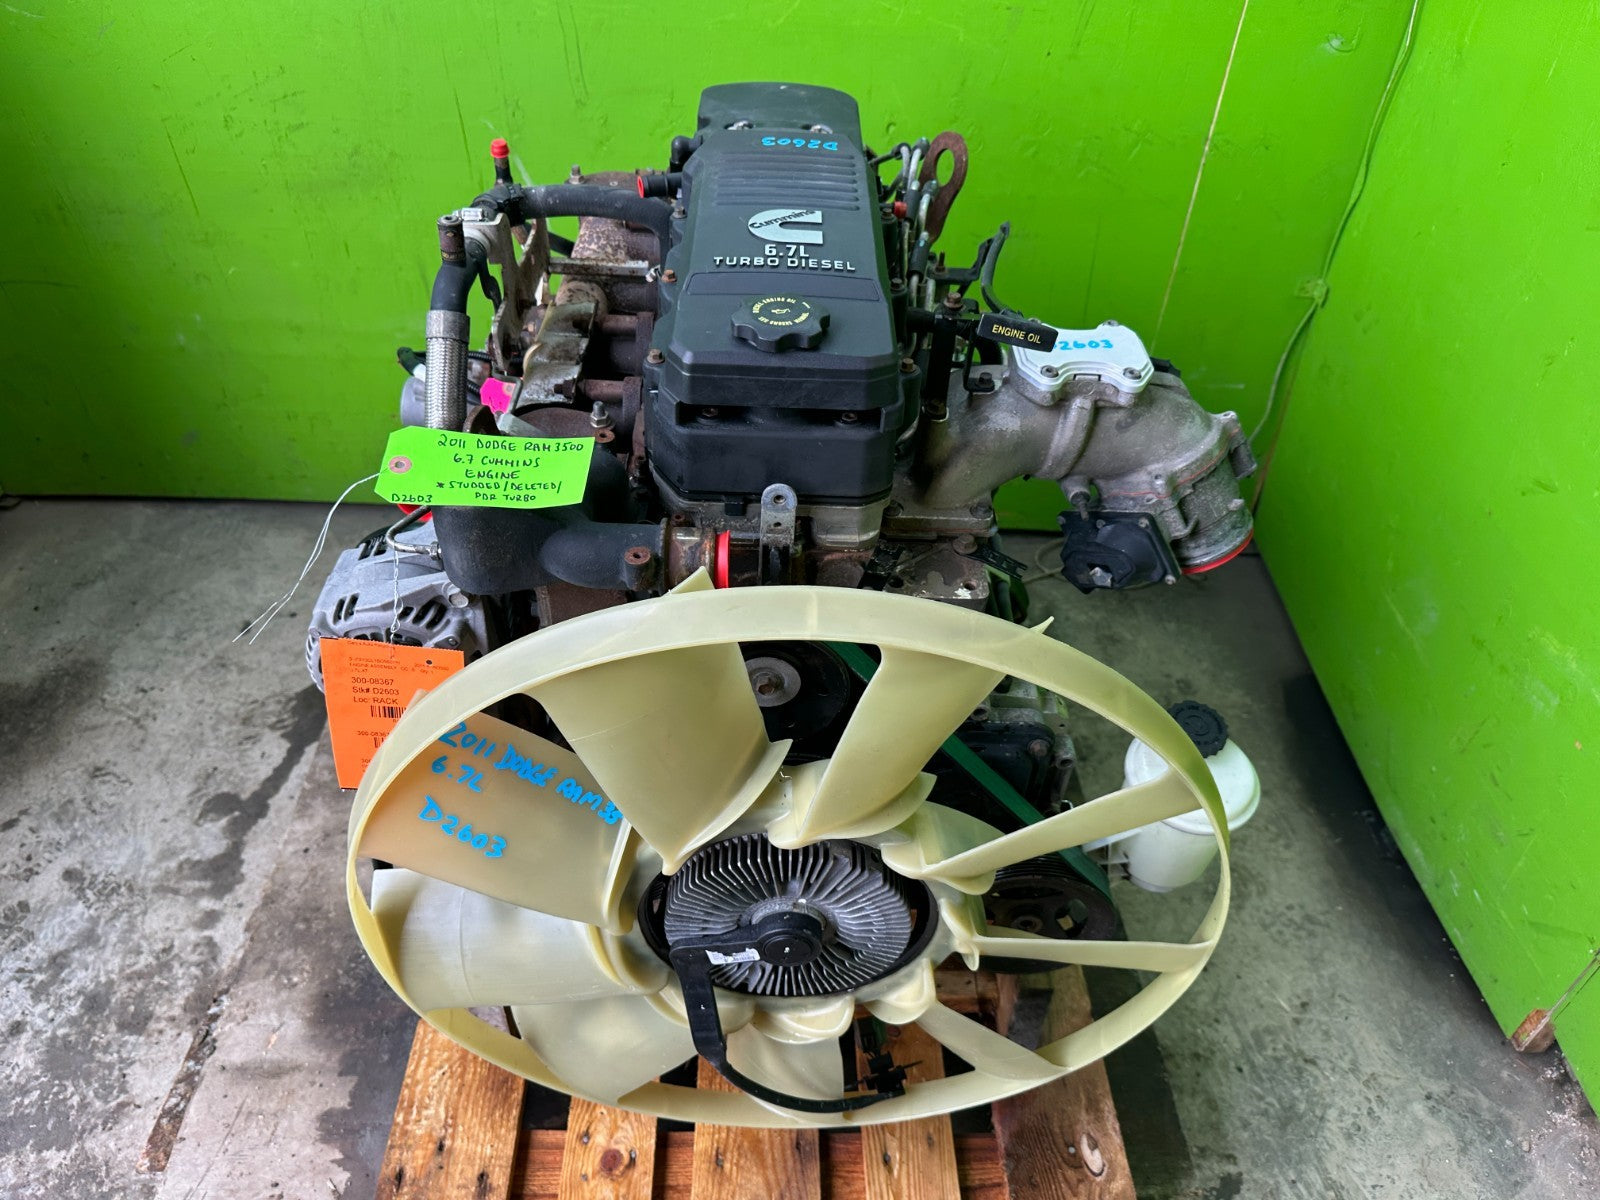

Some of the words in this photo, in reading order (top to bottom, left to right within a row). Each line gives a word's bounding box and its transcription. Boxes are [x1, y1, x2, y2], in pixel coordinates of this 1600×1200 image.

[761, 136, 838, 151] D2603
[764, 244, 810, 257] 6.7L
[713, 256, 779, 267] TURBO
[787, 258, 856, 271] DIESEL
[992, 324, 1026, 340] ENGINE
[1027, 333, 1042, 344] OIL
[1054, 338, 1114, 351] 2603
[438, 433, 466, 449] 2011
[476, 438, 517, 451] DODGE
[524, 441, 551, 451] RAM
[553, 441, 584, 451] 3500
[453, 453, 474, 464] 6.7
[481, 455, 541, 468] CUMMINS
[465, 469, 521, 479] ENGINE
[391, 493, 433, 503] D2603
[503, 494, 537, 503] TURBO
[372, 697, 399, 705] RACK
[438, 720, 496, 758] 2011
[556, 778, 603, 810] RAM
[431, 755, 484, 793] 6.7L
[418, 795, 507, 858] D2603
